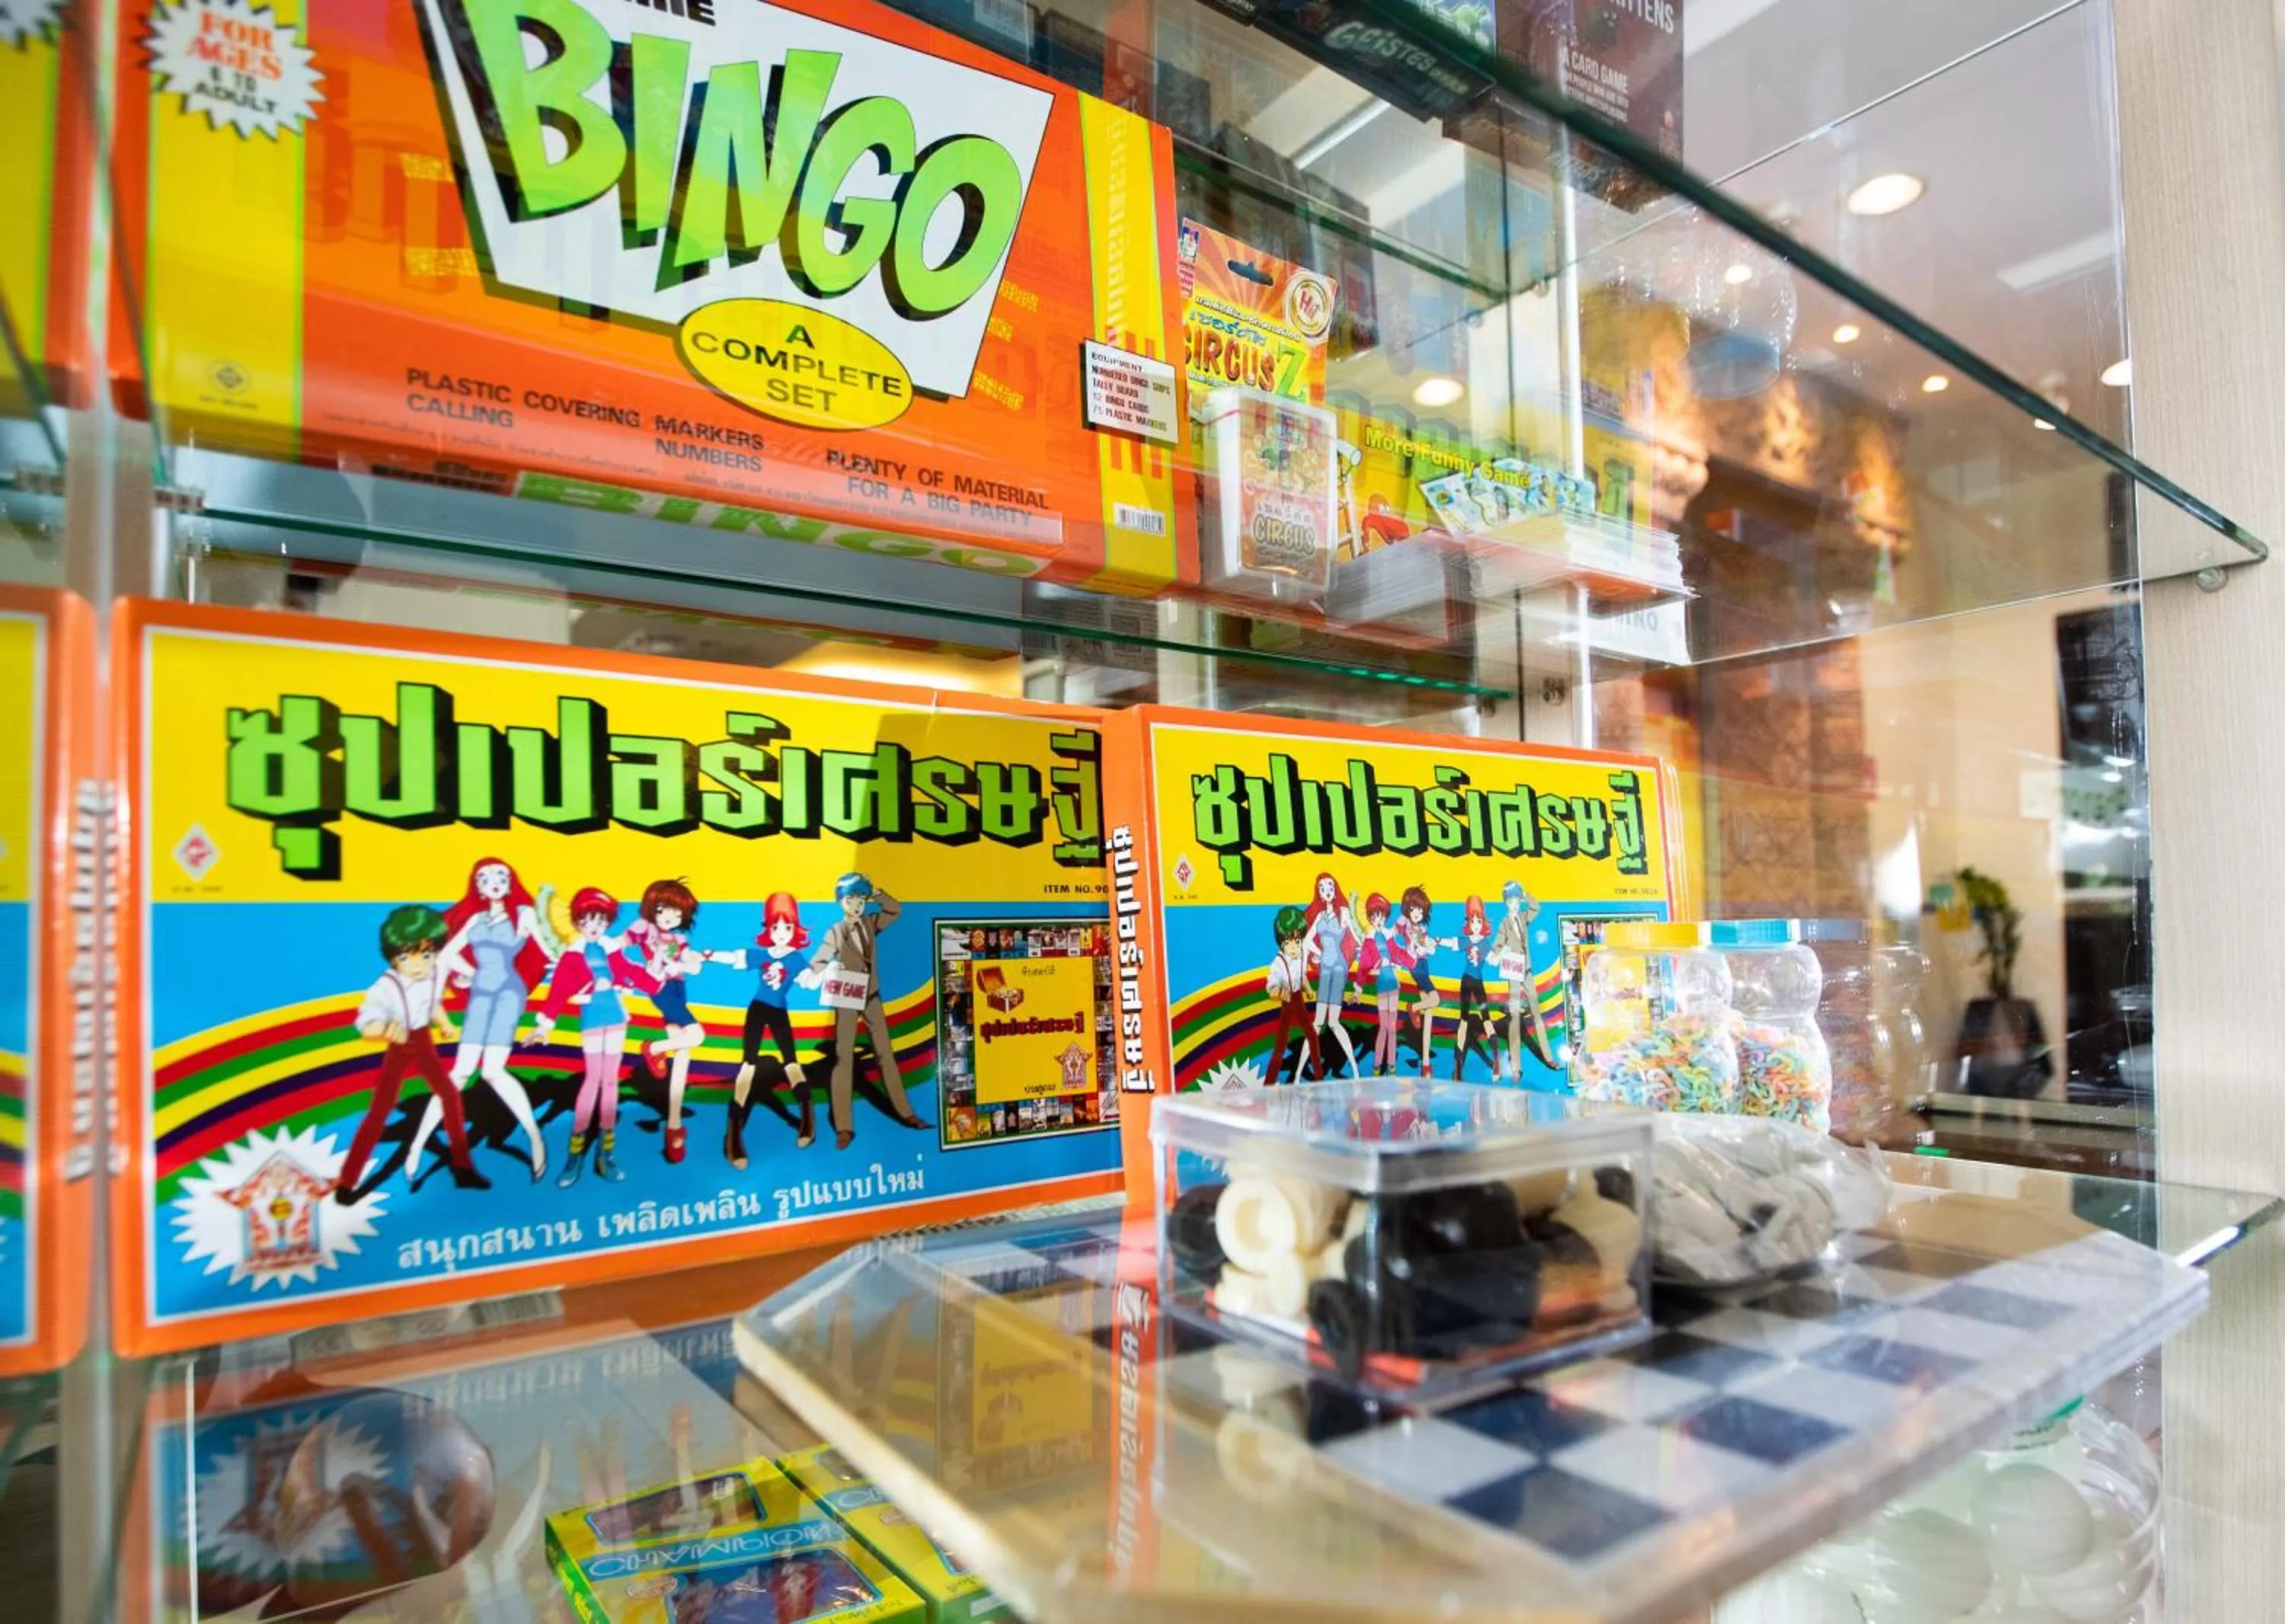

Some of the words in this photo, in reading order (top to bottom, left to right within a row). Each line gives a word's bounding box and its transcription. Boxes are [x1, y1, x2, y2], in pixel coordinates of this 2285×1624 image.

[198, 10, 273, 51] FOR
[188, 36, 283, 81] AGES
[194, 80, 278, 113] ADULT
[461, 0, 1022, 321] BINGO
[785, 323, 816, 350] A
[690, 331, 903, 398] COMPLETE
[1091, 351, 1143, 372] EQUIPMENT
[406, 368, 513, 404] PLASTIC
[523, 390, 641, 428] COVERING
[655, 414, 765, 450] MARKERS
[765, 378, 838, 414] SET
[407, 393, 514, 428] CALLING
[655, 437, 762, 472] NUMBERS
[1365, 424, 1415, 458] More
[826, 449, 907, 481] PLENTY
[918, 467, 944, 488] OF
[954, 474, 1049, 510] MATERIAL
[847, 476, 890, 500] FOR
[900, 488, 916, 506] A
[927, 491, 960, 513] BIG
[970, 499, 1032, 527] PARTY
[1254, 513, 1316, 555] CIRCUS
[1043, 884, 1069, 894] ITEM
[843, 982, 865, 1000] GAME
[398, 1222, 582, 1273] สนุกสนาน
[597, 1188, 761, 1239] เพลิดเพลิน
[772, 1153, 924, 1219] รูปแบบใหม่
